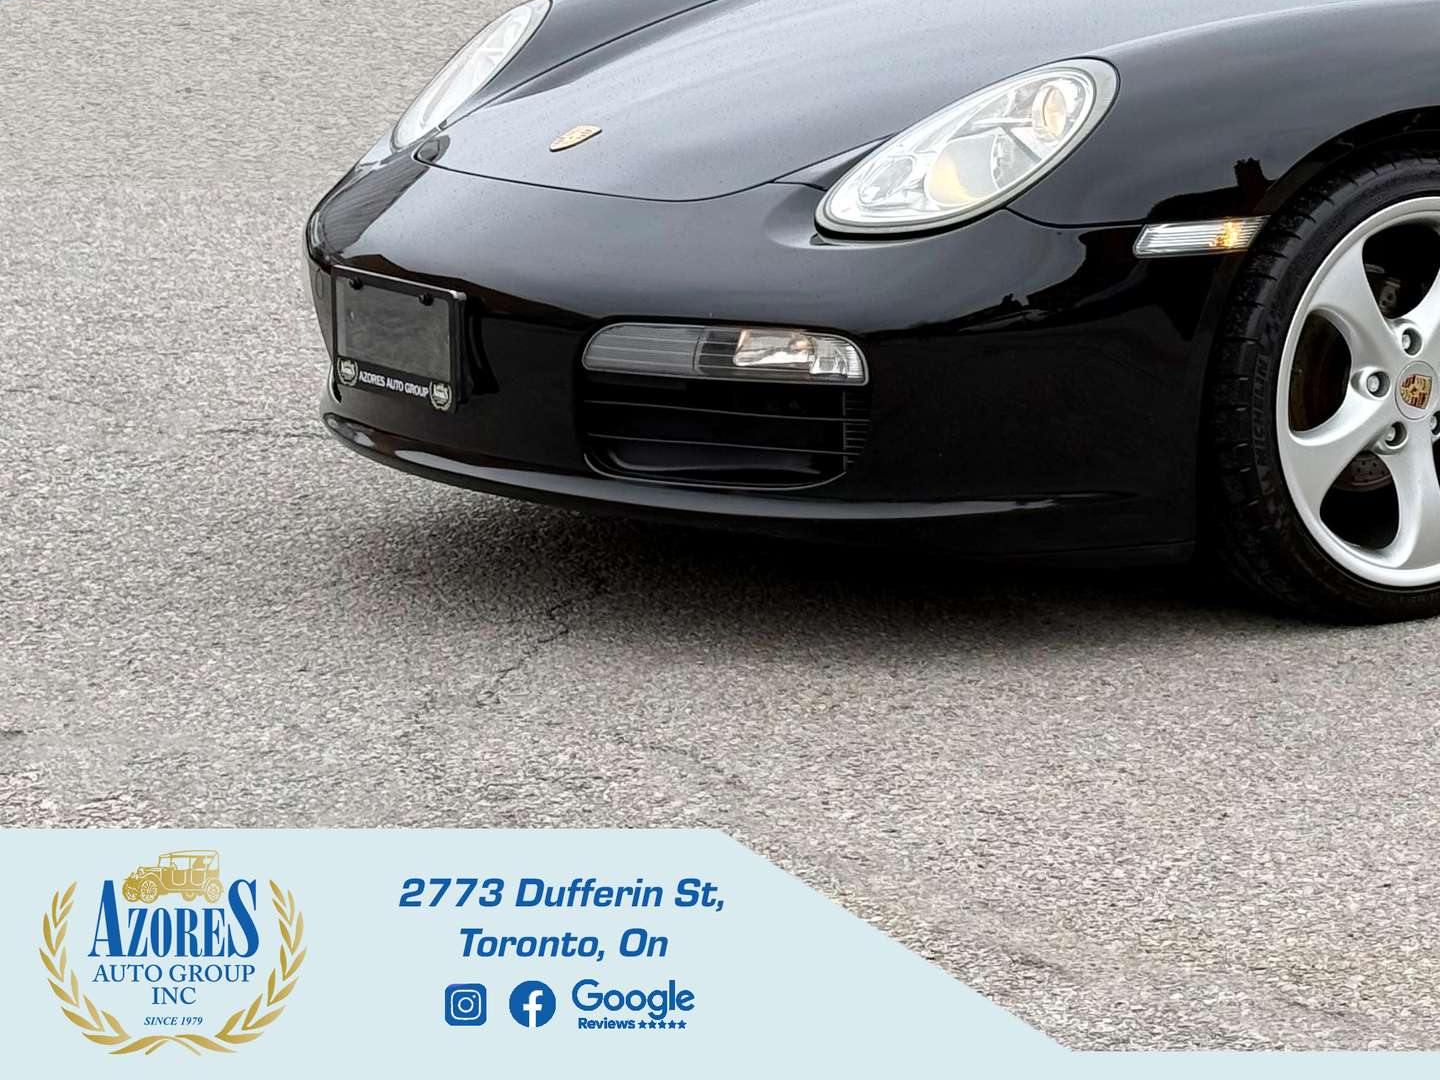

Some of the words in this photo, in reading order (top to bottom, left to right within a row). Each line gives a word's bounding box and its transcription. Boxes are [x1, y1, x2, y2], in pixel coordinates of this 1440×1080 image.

[359, 370, 385, 387] AZORES
[386, 377, 404, 392] AUTO
[405, 383, 429, 398] GROUP
